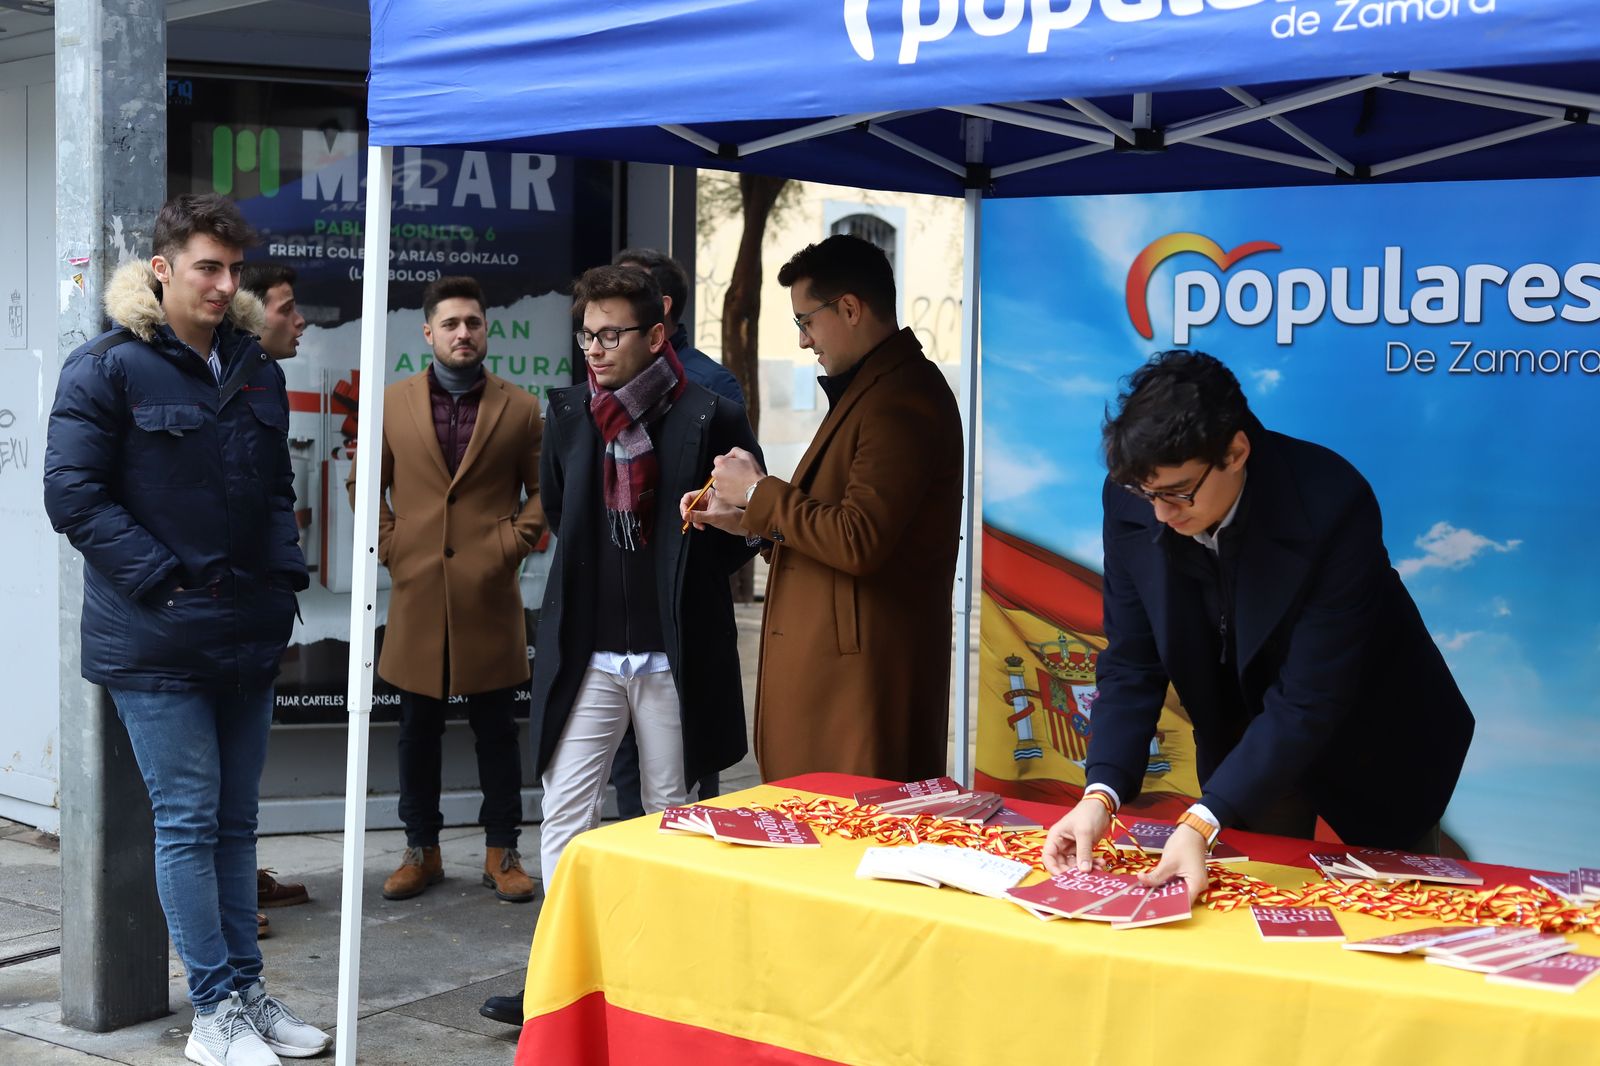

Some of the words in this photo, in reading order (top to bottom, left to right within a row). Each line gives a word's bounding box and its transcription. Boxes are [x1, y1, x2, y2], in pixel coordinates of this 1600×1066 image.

[1271, 6, 1320, 39] de
[302, 129, 556, 211] MLAR
[314, 219, 366, 236] PABL
[485, 228, 497, 241] 6
[269, 244, 323, 259] FRENTE
[326, 246, 395, 261] COLE
[398, 250, 445, 263] ARIAS
[449, 251, 519, 266] GONZALO
[1173, 246, 1600, 345] populares
[1386, 341, 1436, 373] De
[1448, 341, 1600, 373] Zamora
[276, 695, 300, 707] FIJAR
[301, 695, 344, 707] CARTELES
